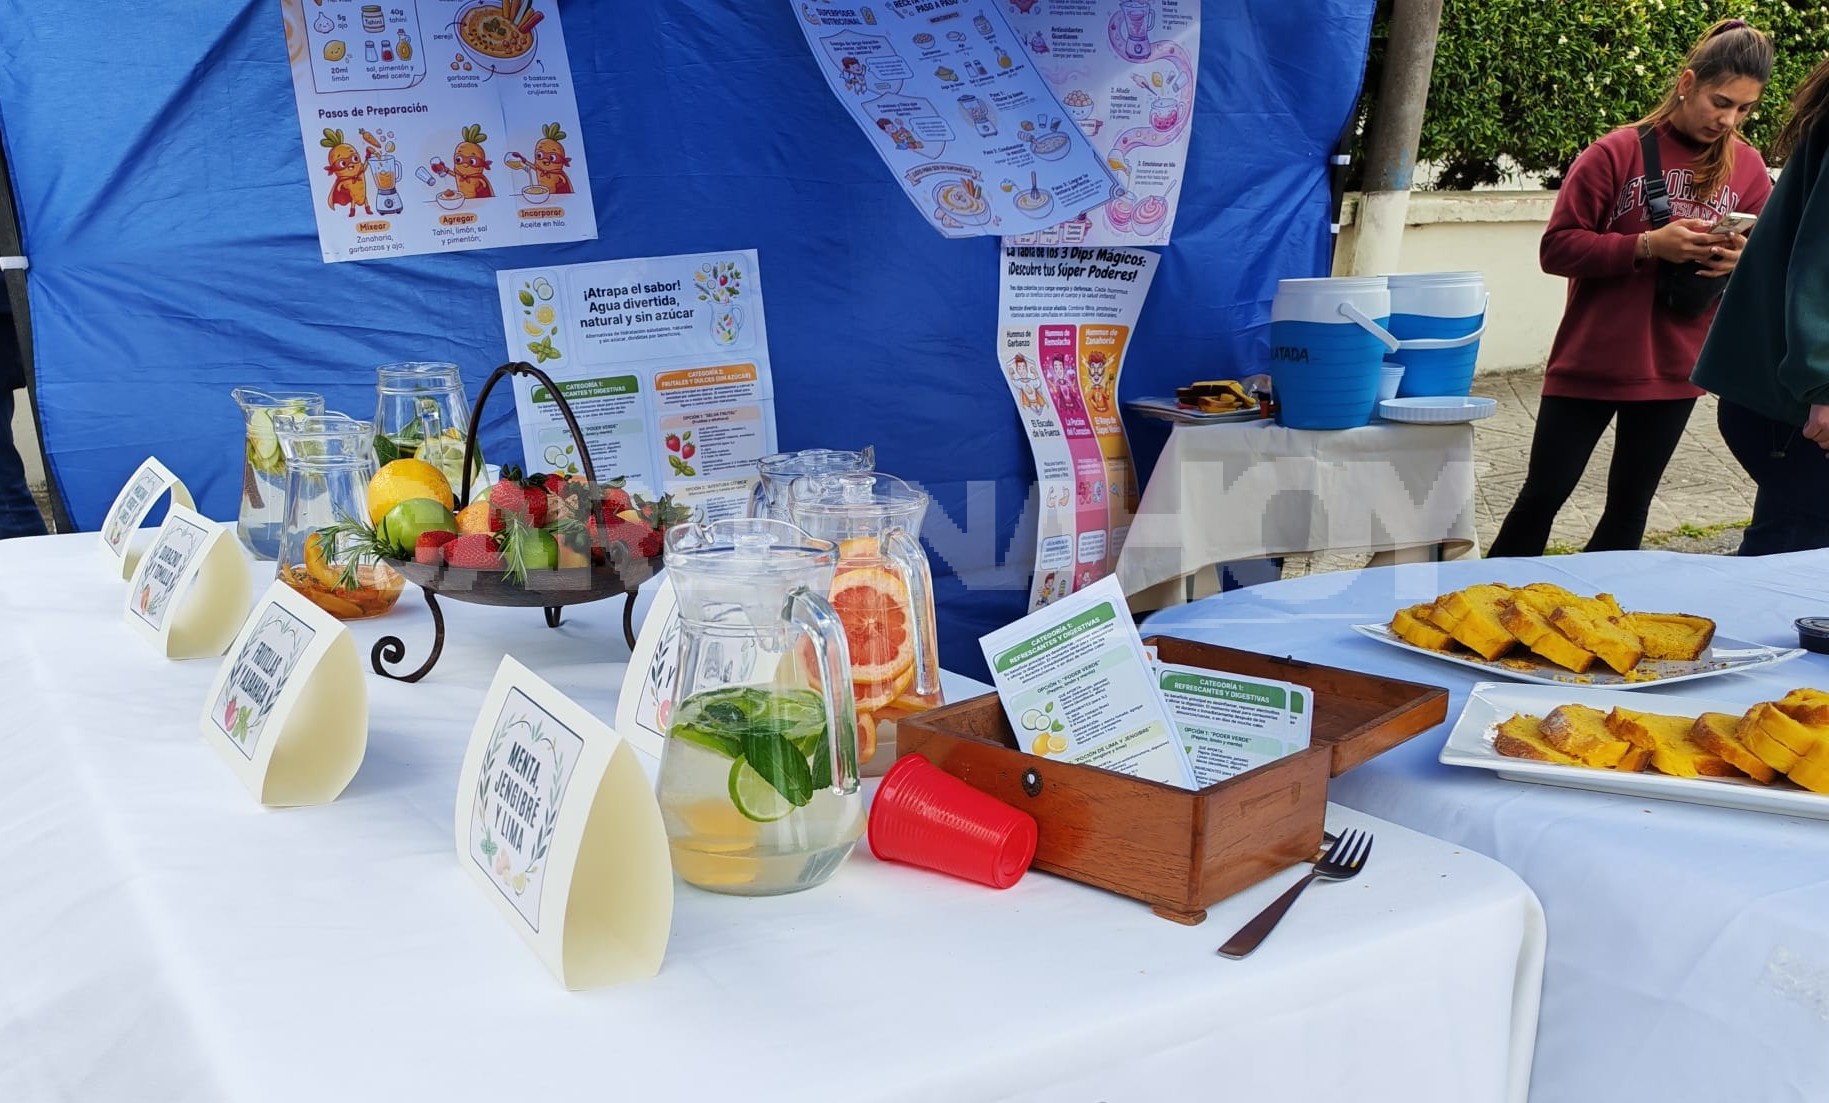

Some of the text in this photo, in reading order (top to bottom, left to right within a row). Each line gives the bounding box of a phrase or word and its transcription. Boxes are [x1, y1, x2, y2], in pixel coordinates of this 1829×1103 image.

[916, 5, 934, 13] PASO
[319, 103, 428, 118] Pasos de Preparación
[442, 215, 474, 225] Agregar
[521, 209, 562, 218] Incorporar
[360, 223, 386, 231] Mixear
[520, 221, 541, 229] Aceite
[357, 235, 393, 244] Zanahoria,
[349, 244, 390, 254] garbanzos y
[1061, 247, 1068, 259] 3
[1071, 247, 1093, 263] Dips
[1096, 247, 1146, 267] Mágicos:
[1009, 262, 1138, 282] ¡Descubre tus Súper Poderes!
[584, 280, 681, 301] ¡Atrapa el sabor!
[590, 296, 680, 315] Agua divertida,
[580, 309, 694, 328] natural y sin azúcar
[1007, 330, 1024, 338] Hummus
[1032, 429, 1039, 437] de
[1045, 428, 1060, 436] Fuerza
[1008, 636, 1058, 664] REFRESCANTES
[1062, 616, 1100, 638] DIGESTIVAS
[1031, 626, 1068, 647] CATEGORÍA
[1036, 679, 1058, 693] OPCIÓN
[1199, 677, 1238, 689] CATEGORÍA
[1174, 682, 1224, 695] REFRESCANTES
[1230, 691, 1269, 702] DIGESTIVAS
[1184, 726, 1204, 734] OPCIÓN
[1104, 740, 1118, 750] LIMA
[507, 741, 541, 794] MENTA,
[495, 803, 524, 855] Y LIMA
